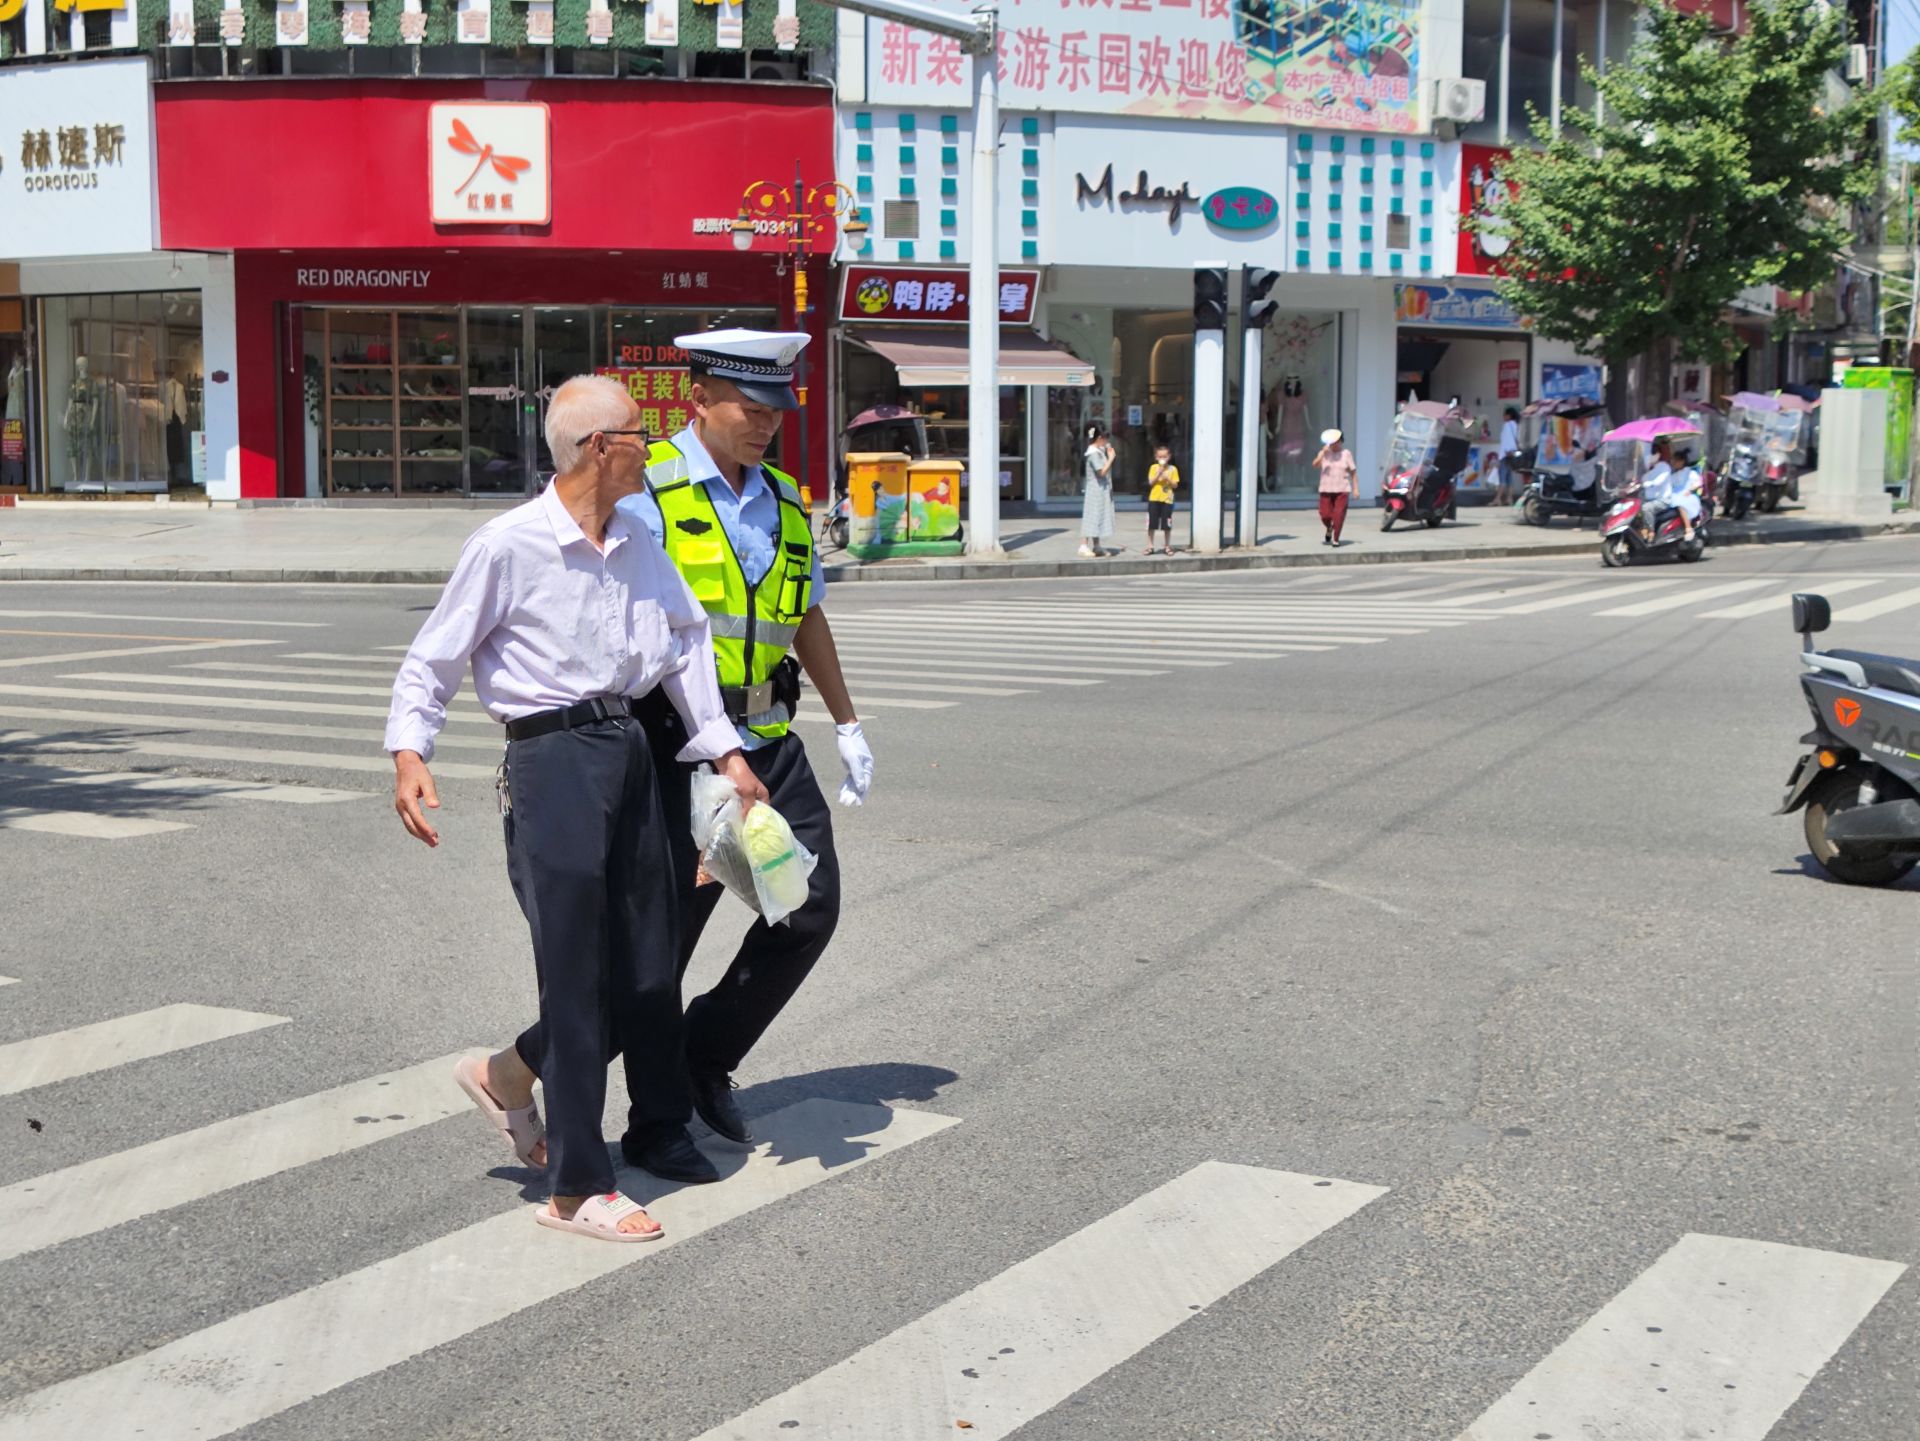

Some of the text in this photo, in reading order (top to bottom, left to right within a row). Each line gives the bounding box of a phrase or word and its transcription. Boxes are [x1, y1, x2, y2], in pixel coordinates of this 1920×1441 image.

[1284, 70, 1409, 101] 本广告位招租
[297, 268, 431, 288] RED DRAGONFLY
[662, 271, 710, 289] 红蜻蜓
[621, 345, 653, 363] RED
